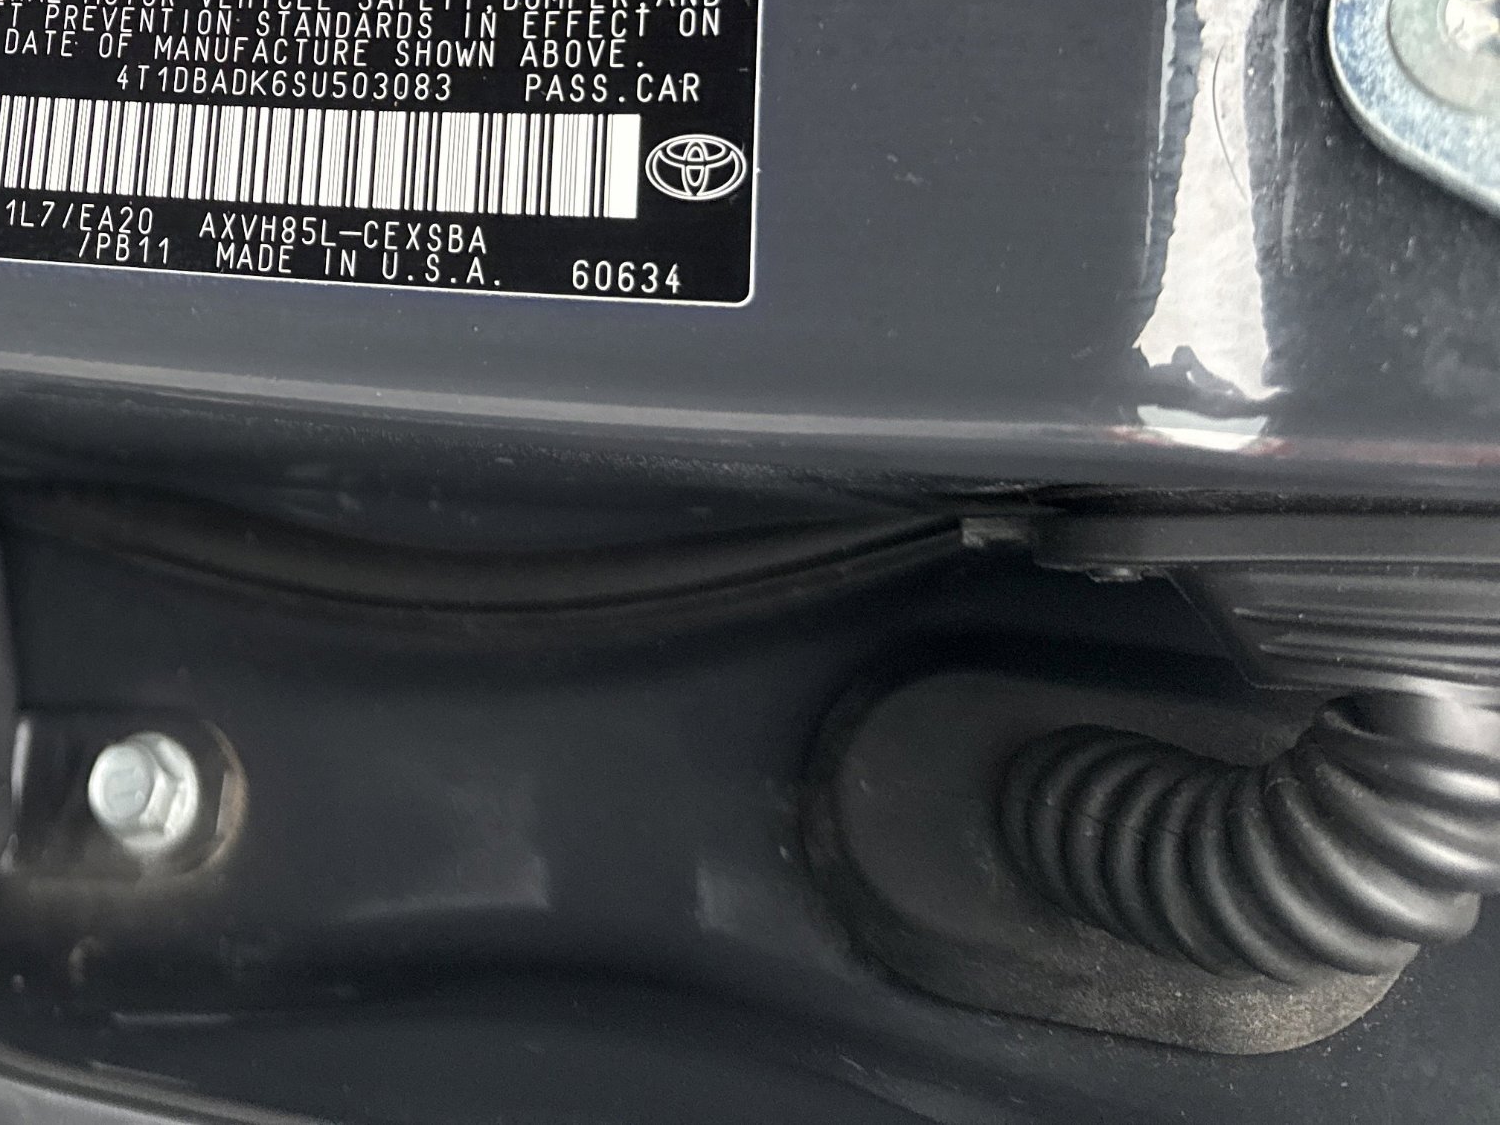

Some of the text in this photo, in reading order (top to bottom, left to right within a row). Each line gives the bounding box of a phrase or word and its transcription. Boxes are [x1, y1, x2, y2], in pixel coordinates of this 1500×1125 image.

[44, 4, 239, 35] PREVENTION
[256, 10, 432, 39] STANDARDS
[464, 11, 497, 39] IN
[522, 5, 650, 42] EFFECT
[678, 7, 720, 37] ON
[4, 27, 76, 57] DATE
[98, 32, 133, 58] OF
[154, 34, 368, 67] MANUFACTURE
[395, 39, 495, 68] SHOWN
[519, 36, 643, 68] ABOVE.
[117, 65, 700, 103] 4T1DBADK6SU503083 PASS.CAR
[199, 212, 486, 254] AXVH85L-CEXSBA
[78, 231, 169, 264] /PB11
[215, 241, 294, 274] MADE
[324, 247, 356, 277] IN
[381, 251, 500, 286] U.S.A.
[572, 259, 680, 294] 60634
